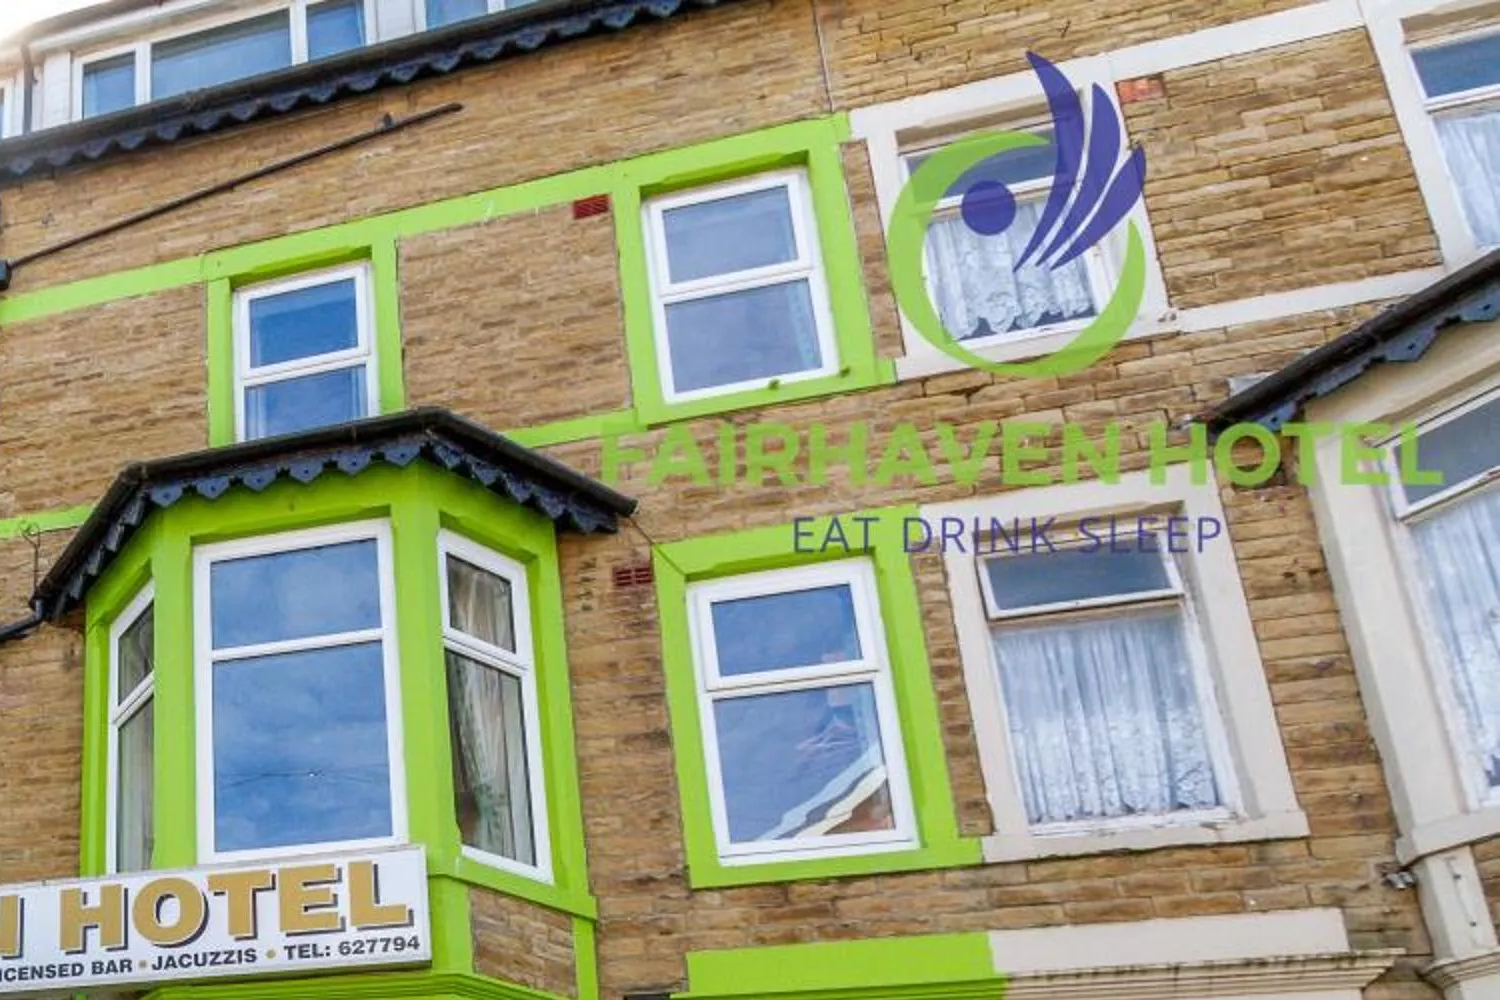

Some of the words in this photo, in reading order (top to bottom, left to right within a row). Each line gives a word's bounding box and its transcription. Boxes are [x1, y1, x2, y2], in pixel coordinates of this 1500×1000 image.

[59, 860, 415, 955] HOTEL
[91, 958, 133, 976] BAR
[151, 947, 258, 971] JACUZZIS
[284, 942, 332, 960] TEL:
[337, 935, 421, 957] 627794
